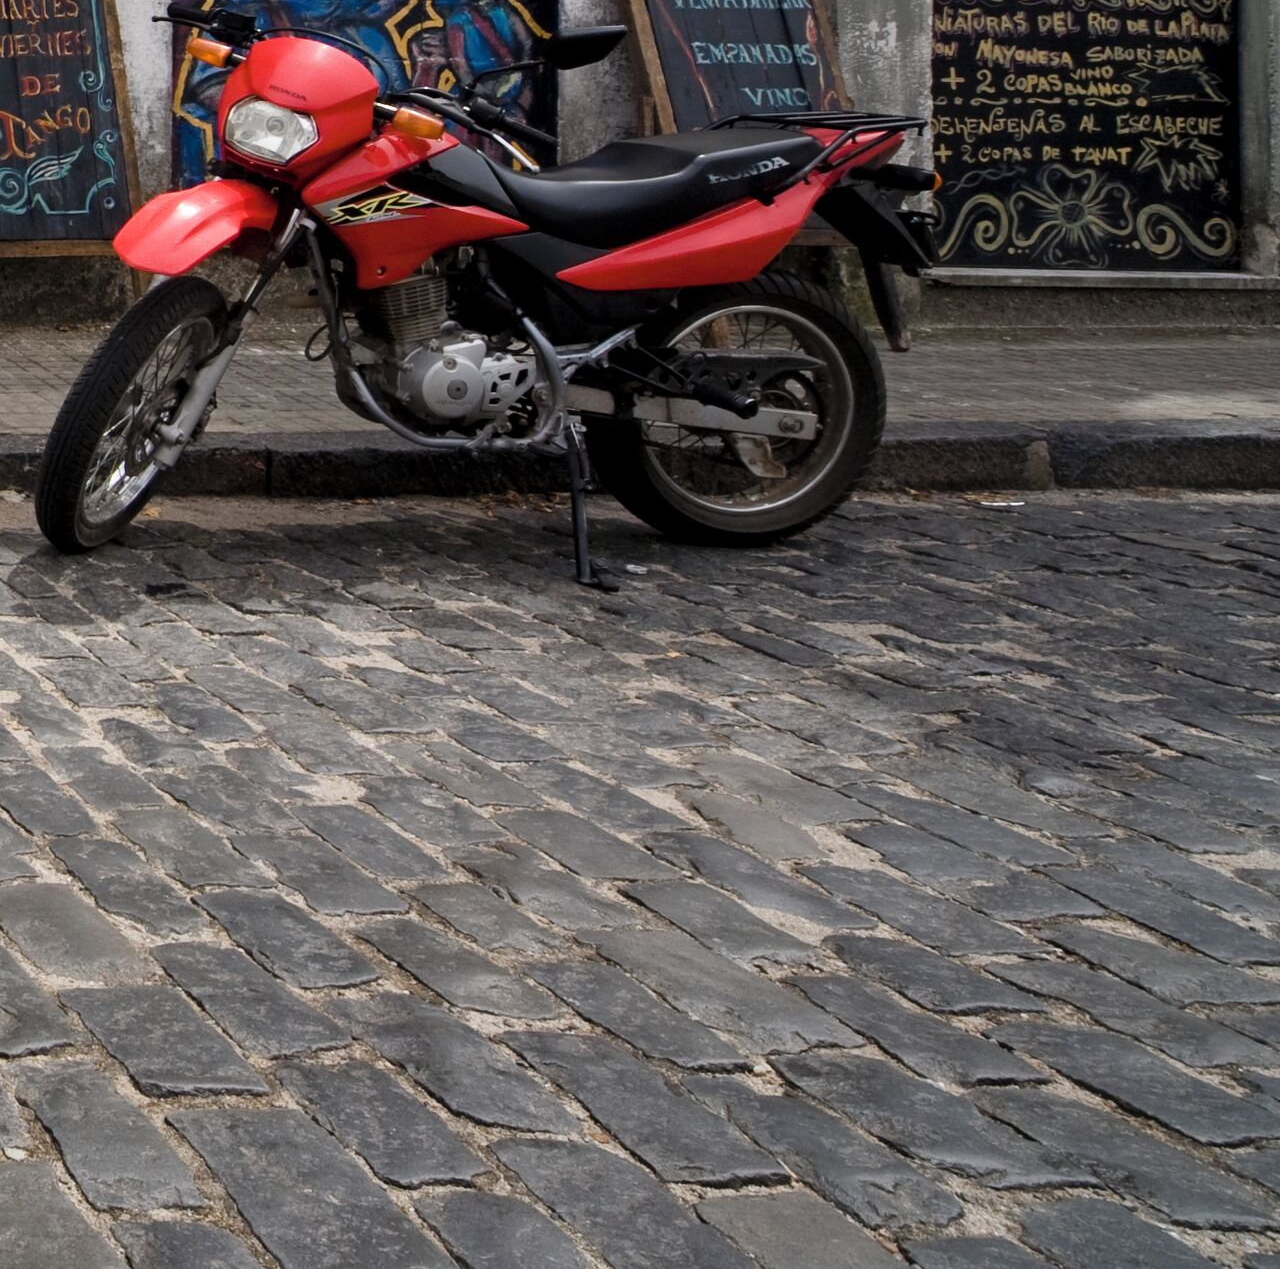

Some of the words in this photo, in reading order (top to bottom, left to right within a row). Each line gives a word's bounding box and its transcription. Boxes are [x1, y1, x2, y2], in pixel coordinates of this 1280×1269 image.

[1038, 11, 1080, 35] DEL
[1127, 18, 1150, 34] DE
[691, 41, 818, 66] EMPANADAS
[931, 41, 958, 59] ON
[976, 37, 1074, 69] MAYONESA
[976, 69, 997, 94] 2
[1004, 74, 1062, 93] COPAS
[1070, 65, 1114, 80] VINO
[21, 73, 61, 97] DE
[1064, 82, 1132, 97] BLANCO
[1079, 114, 1102, 134] AL
[1116, 113, 1224, 137] ESCABECHE
[961, 145, 976, 164] 2
[978, 146, 1032, 163] COPAS
[1042, 146, 1061, 161] DE
[326, 191, 426, 225] XR
